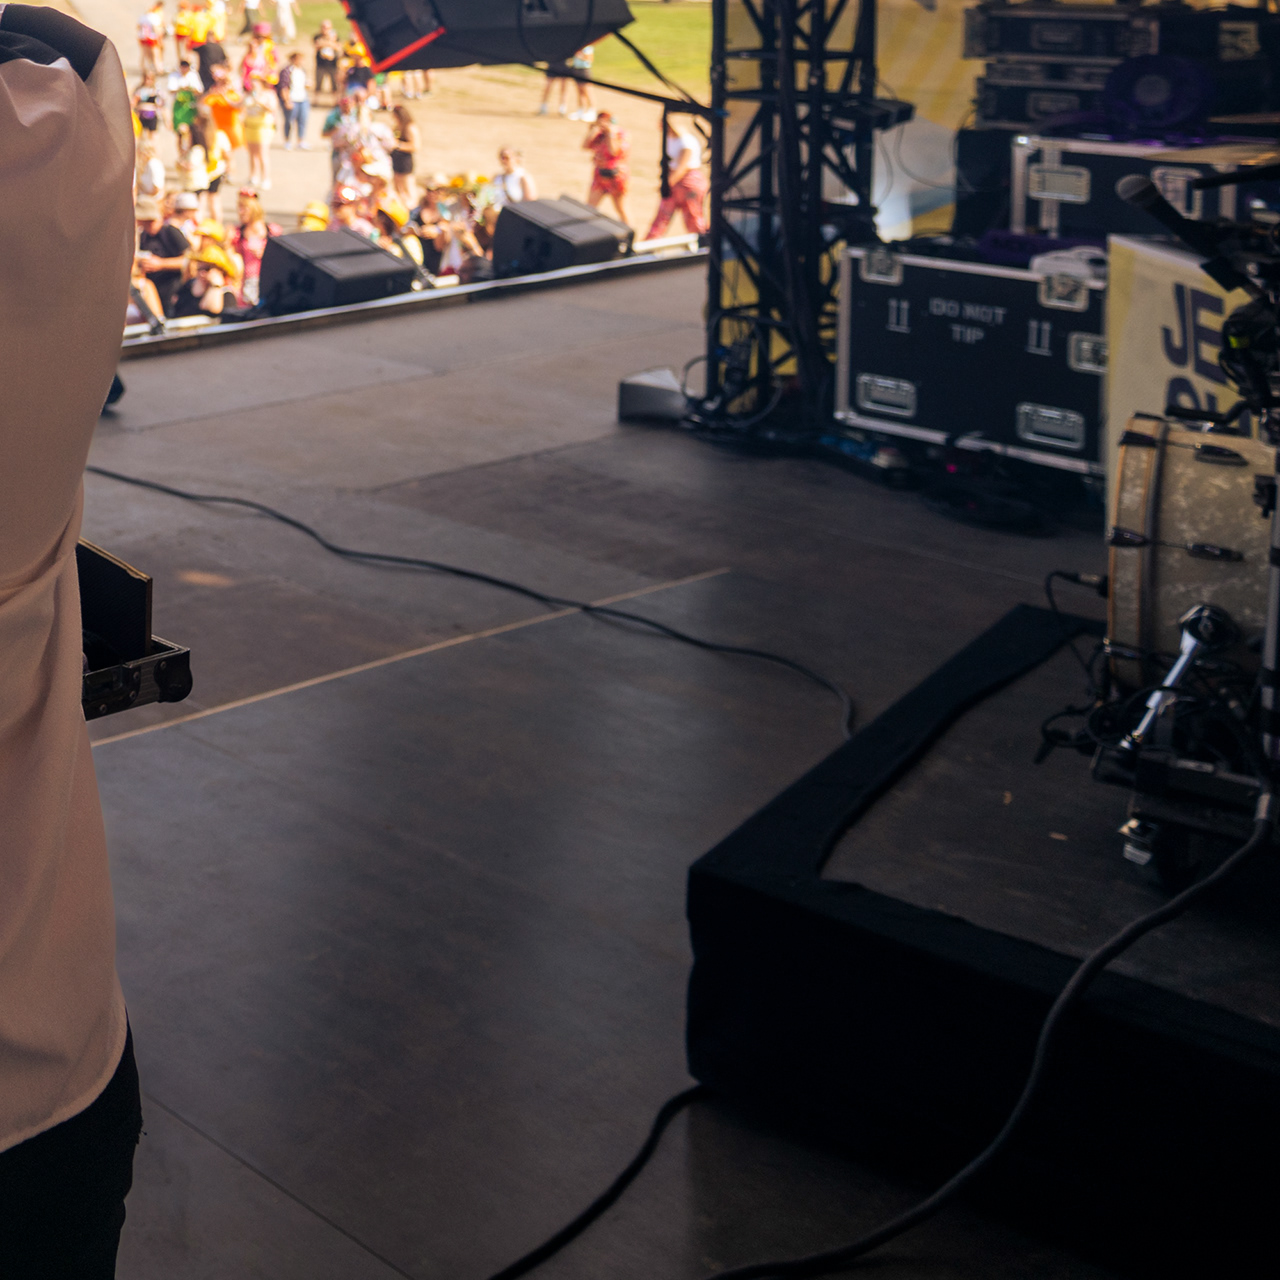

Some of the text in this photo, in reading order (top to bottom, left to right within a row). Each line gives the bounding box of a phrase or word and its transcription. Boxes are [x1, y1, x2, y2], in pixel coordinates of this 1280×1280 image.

[928, 297, 1007, 324] DO NOT
[950, 323, 985, 344] TIP
